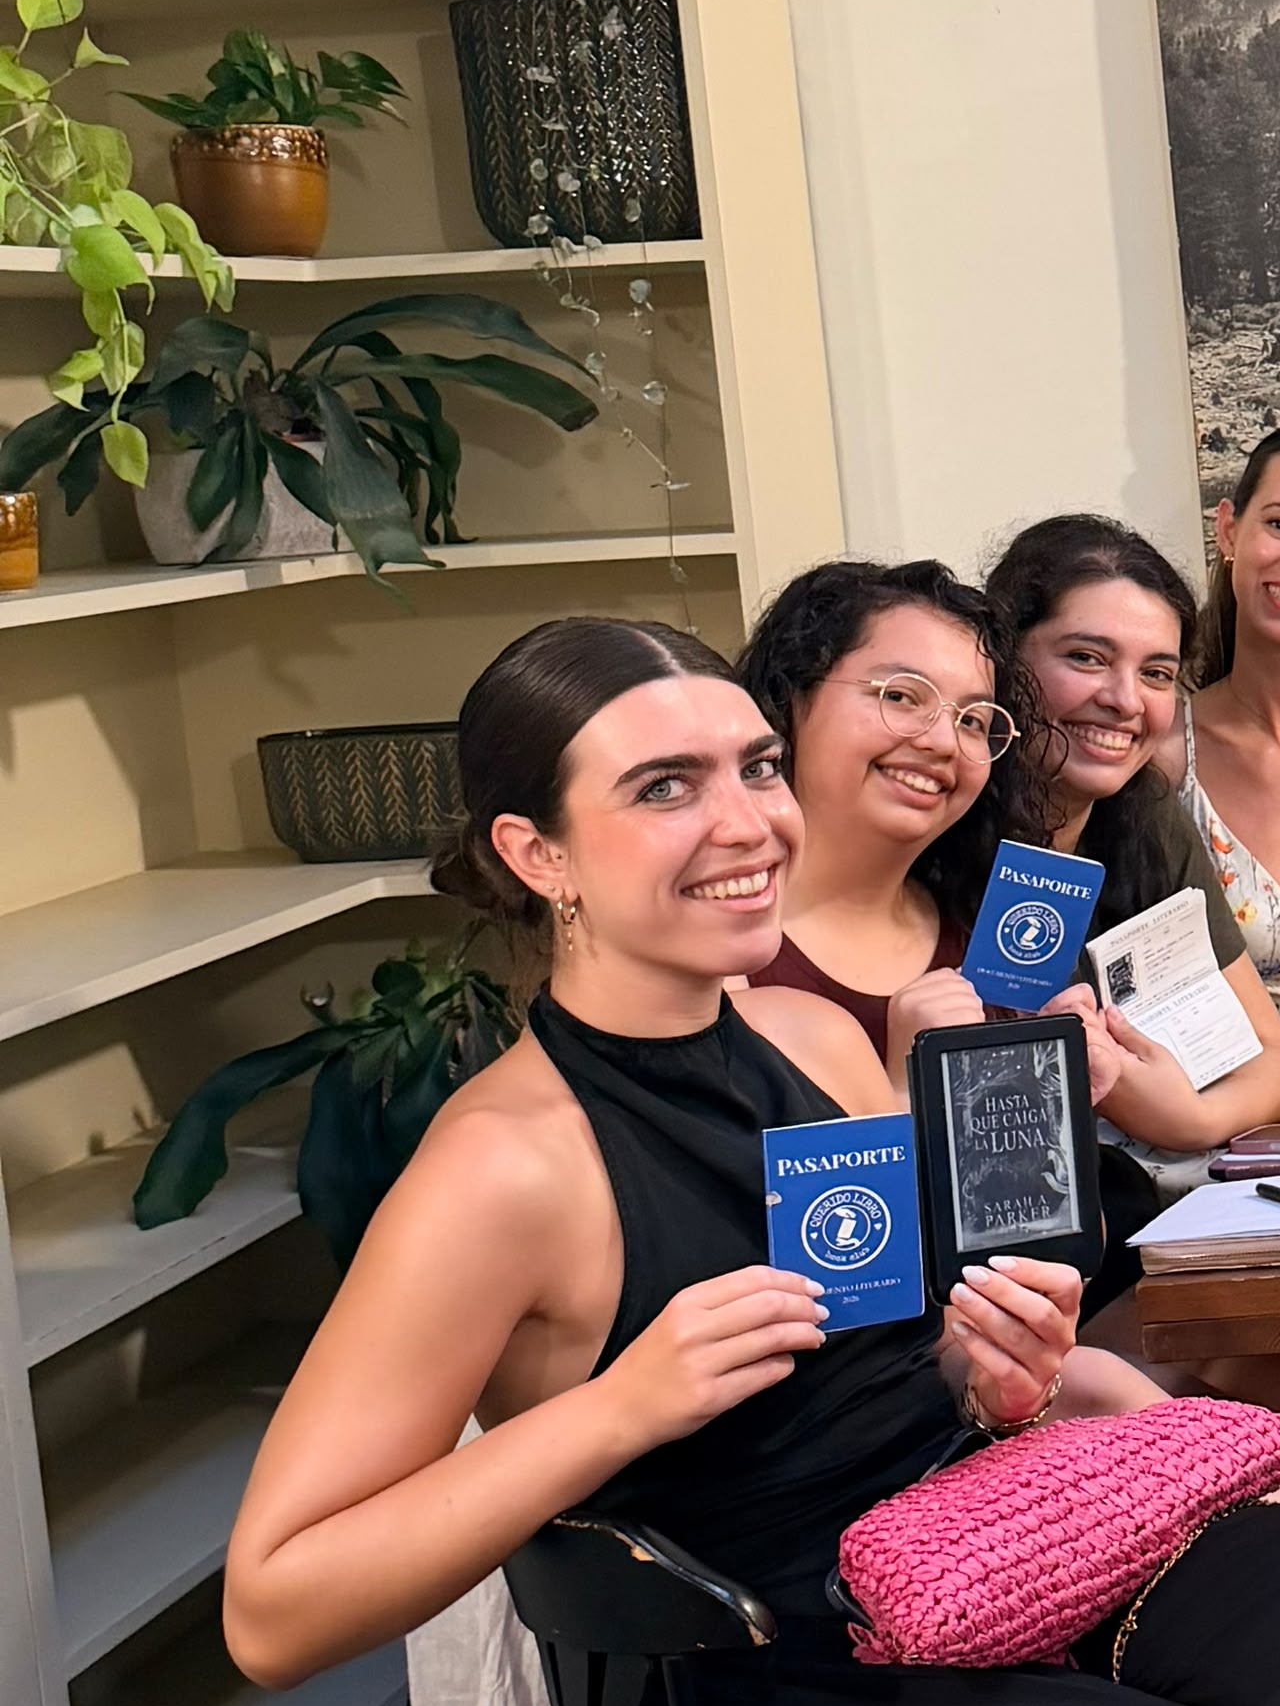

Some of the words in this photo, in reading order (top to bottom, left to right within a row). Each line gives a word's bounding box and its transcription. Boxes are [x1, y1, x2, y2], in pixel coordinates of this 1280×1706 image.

[999, 865, 1093, 900] PASAPORTE
[985, 1094, 1030, 1113] HASTA
[971, 1114, 1000, 1135] QUE
[1002, 1108, 1048, 1128] CAIGA
[975, 1139, 989, 1151] LA
[990, 1128, 1046, 1154] LUNA
[777, 1145, 906, 1177] PASAPORTE
[809, 1192, 851, 1228] QUERIDO
[853, 1192, 882, 1220] LIBRO
[984, 1196, 1032, 1214] SARAH
[985, 1205, 1051, 1228] PARKER
